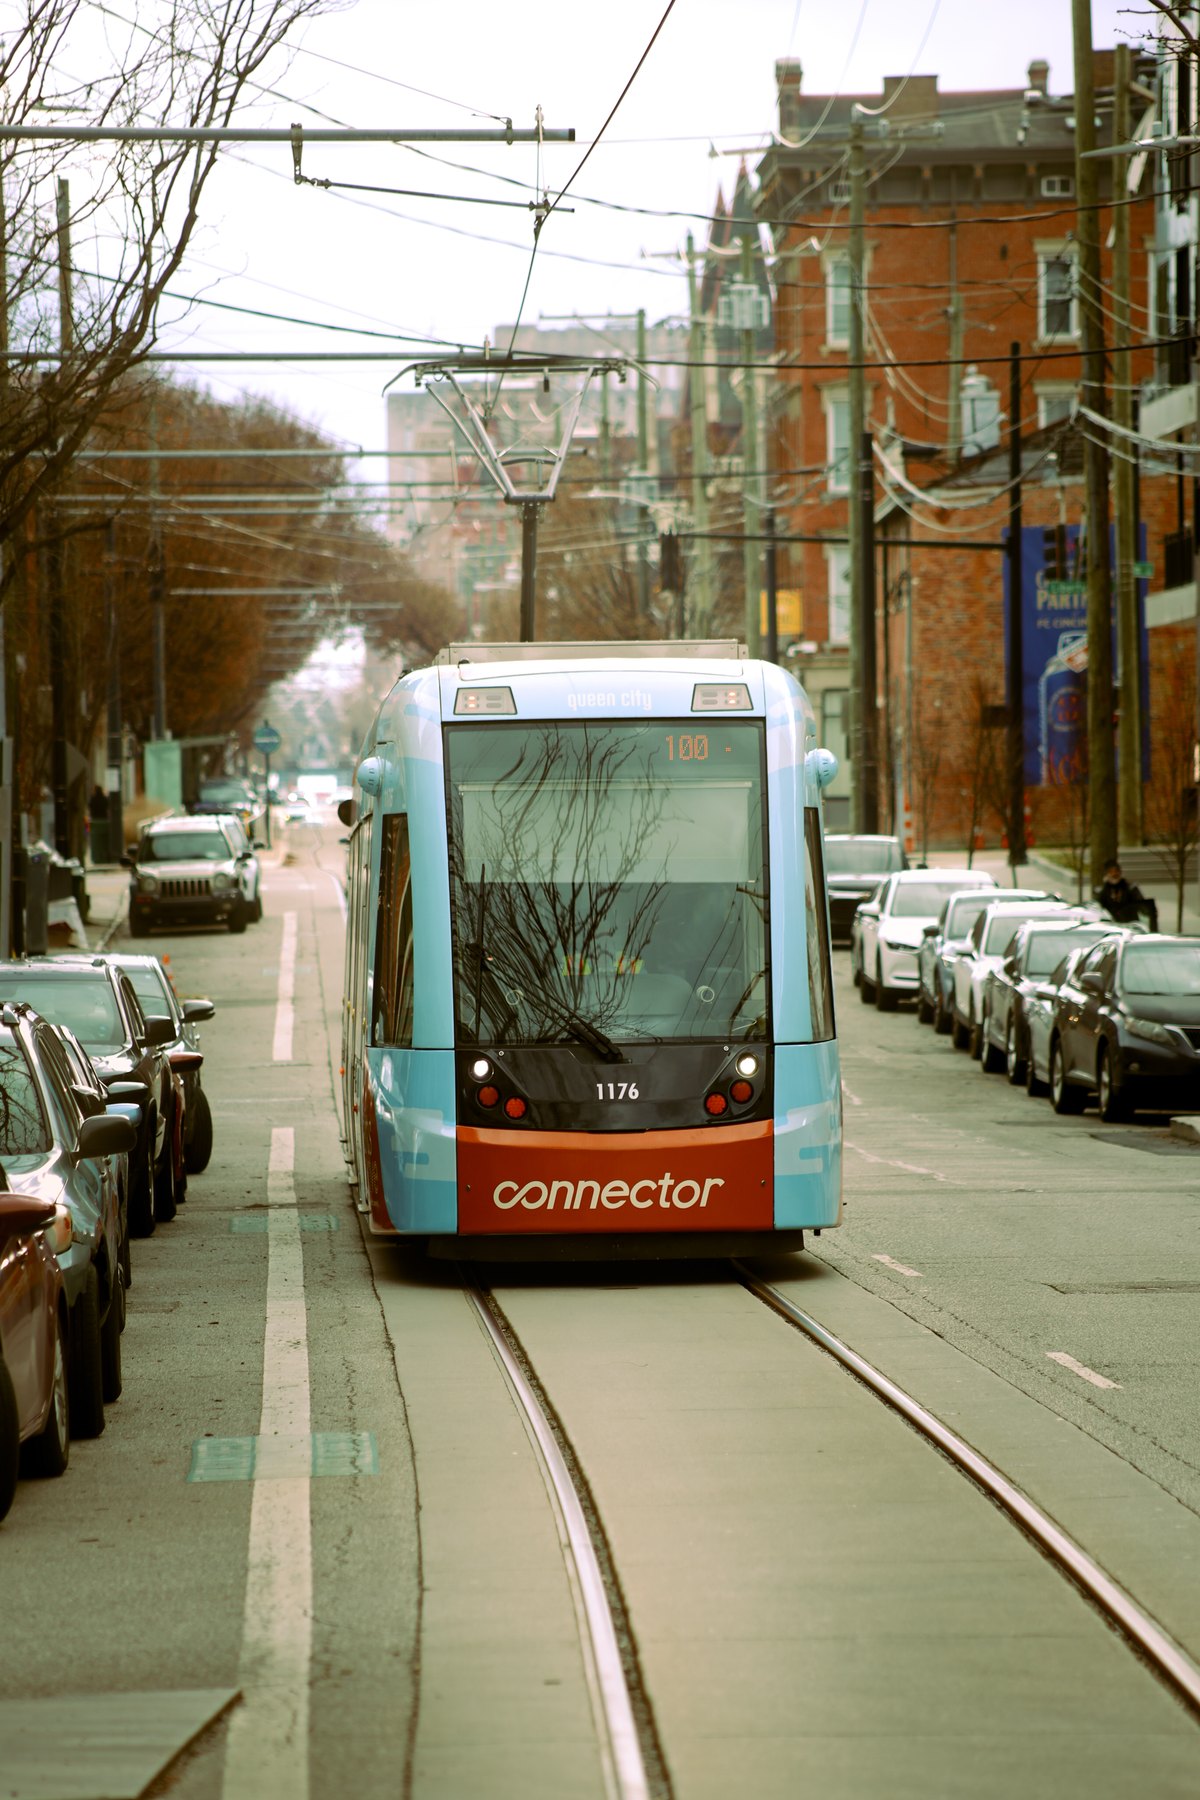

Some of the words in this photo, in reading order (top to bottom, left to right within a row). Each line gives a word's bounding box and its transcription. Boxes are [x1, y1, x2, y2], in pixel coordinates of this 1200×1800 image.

[567, 691, 616, 711] queen
[621, 688, 652, 711] city
[665, 735, 708, 761] 100
[596, 1083, 640, 1100] 1176
[493, 1172, 725, 1210] connector
